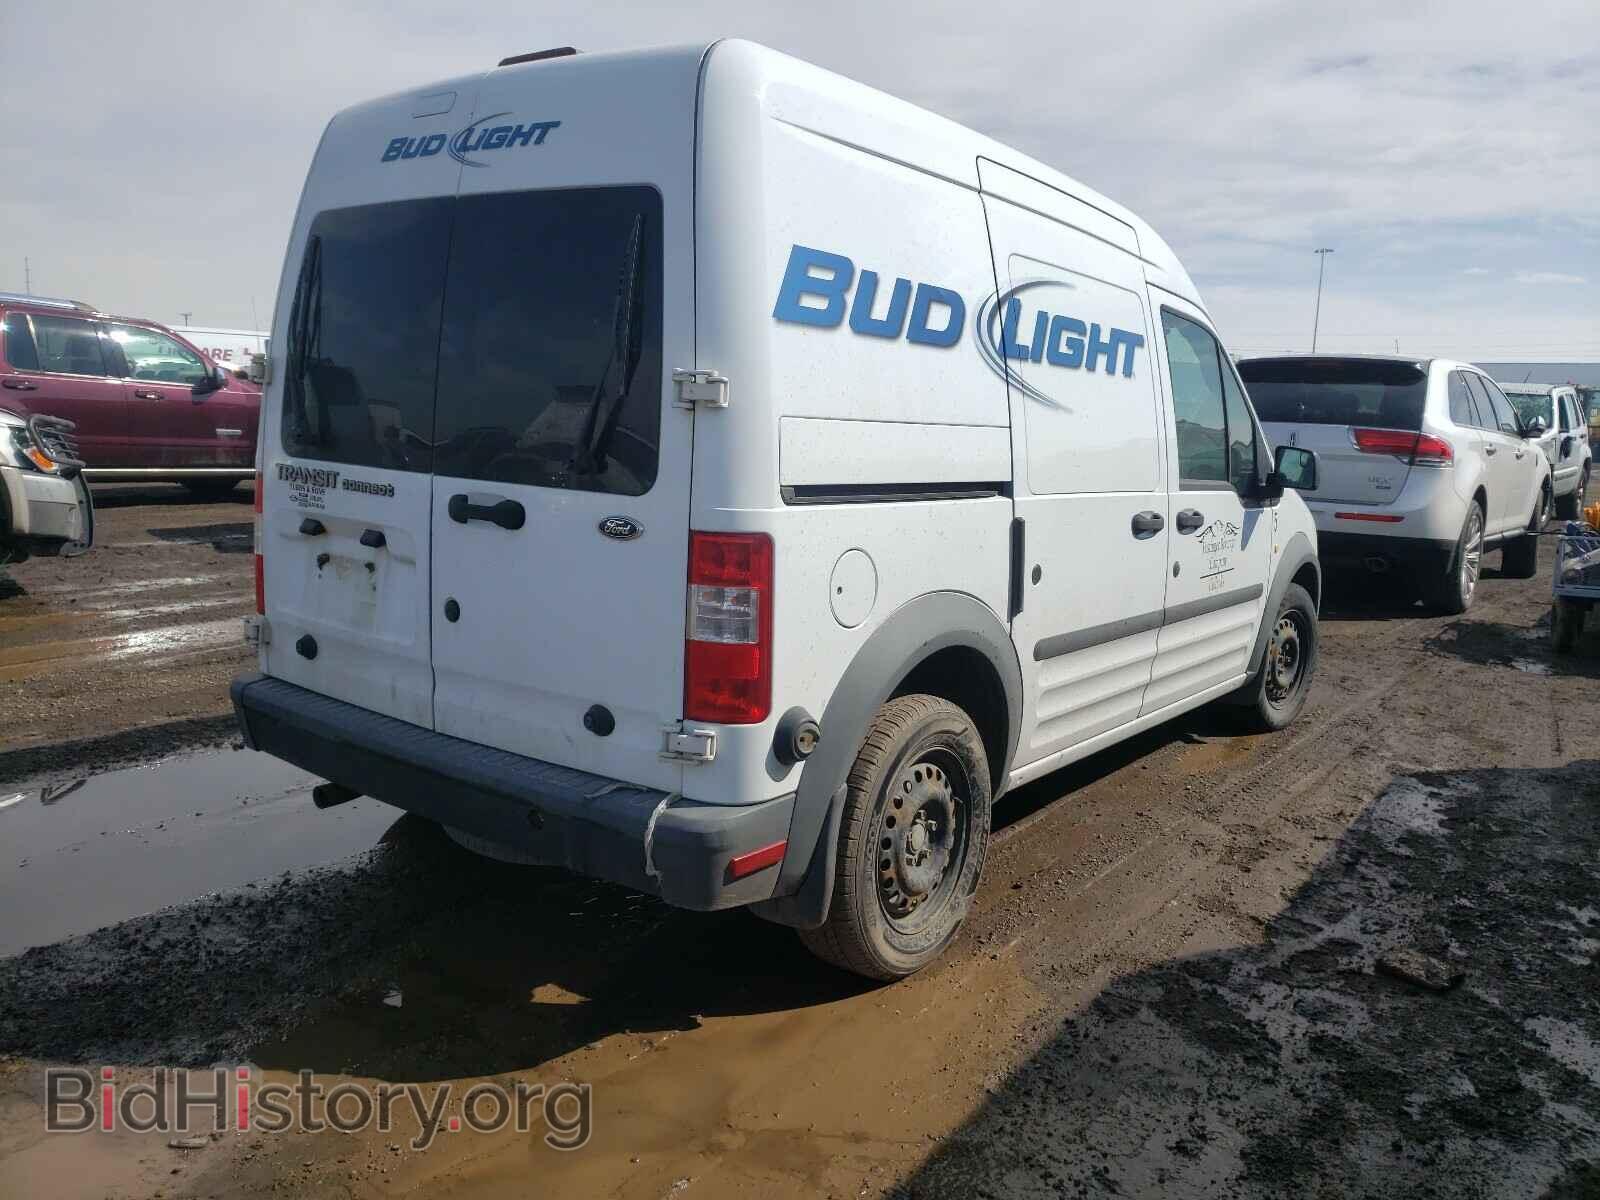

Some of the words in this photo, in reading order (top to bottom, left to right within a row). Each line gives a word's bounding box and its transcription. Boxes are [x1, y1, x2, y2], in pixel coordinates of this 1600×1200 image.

[381, 133, 448, 163] BUD
[454, 120, 562, 153] LIGHT
[772, 244, 966, 348] BUD
[998, 297, 1145, 378] LIGHT
[275, 463, 339, 489] TRANSIT
[342, 479, 395, 498] connect
